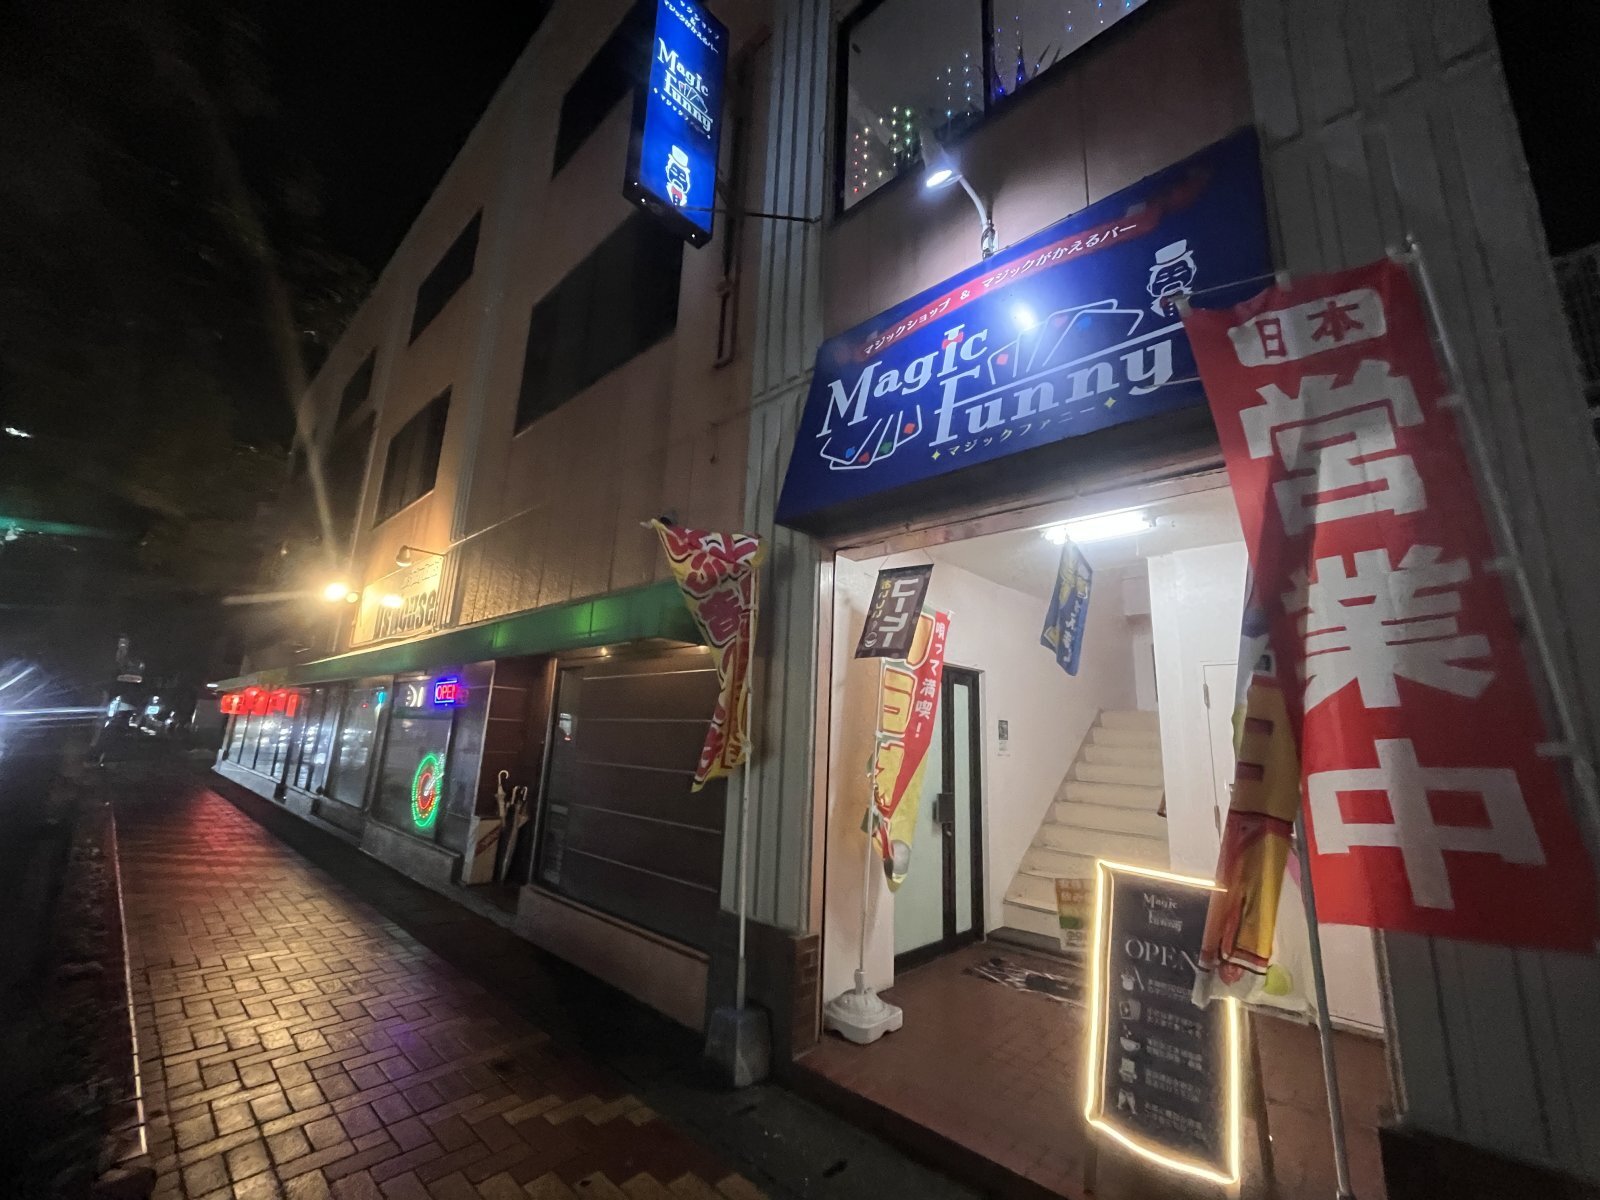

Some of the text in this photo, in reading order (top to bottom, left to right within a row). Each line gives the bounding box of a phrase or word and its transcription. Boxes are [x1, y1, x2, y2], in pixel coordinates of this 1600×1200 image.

[657, 37, 709, 97] Magic
[663, 69, 713, 132] Funny
[864, 223, 1137, 355] マジックショップ & マジックがかえるバー
[816, 324, 989, 439] Magic
[929, 337, 1175, 448] Funny
[947, 406, 1097, 457] マジックファニー
[1124, 937, 1199, 972] OPEN
